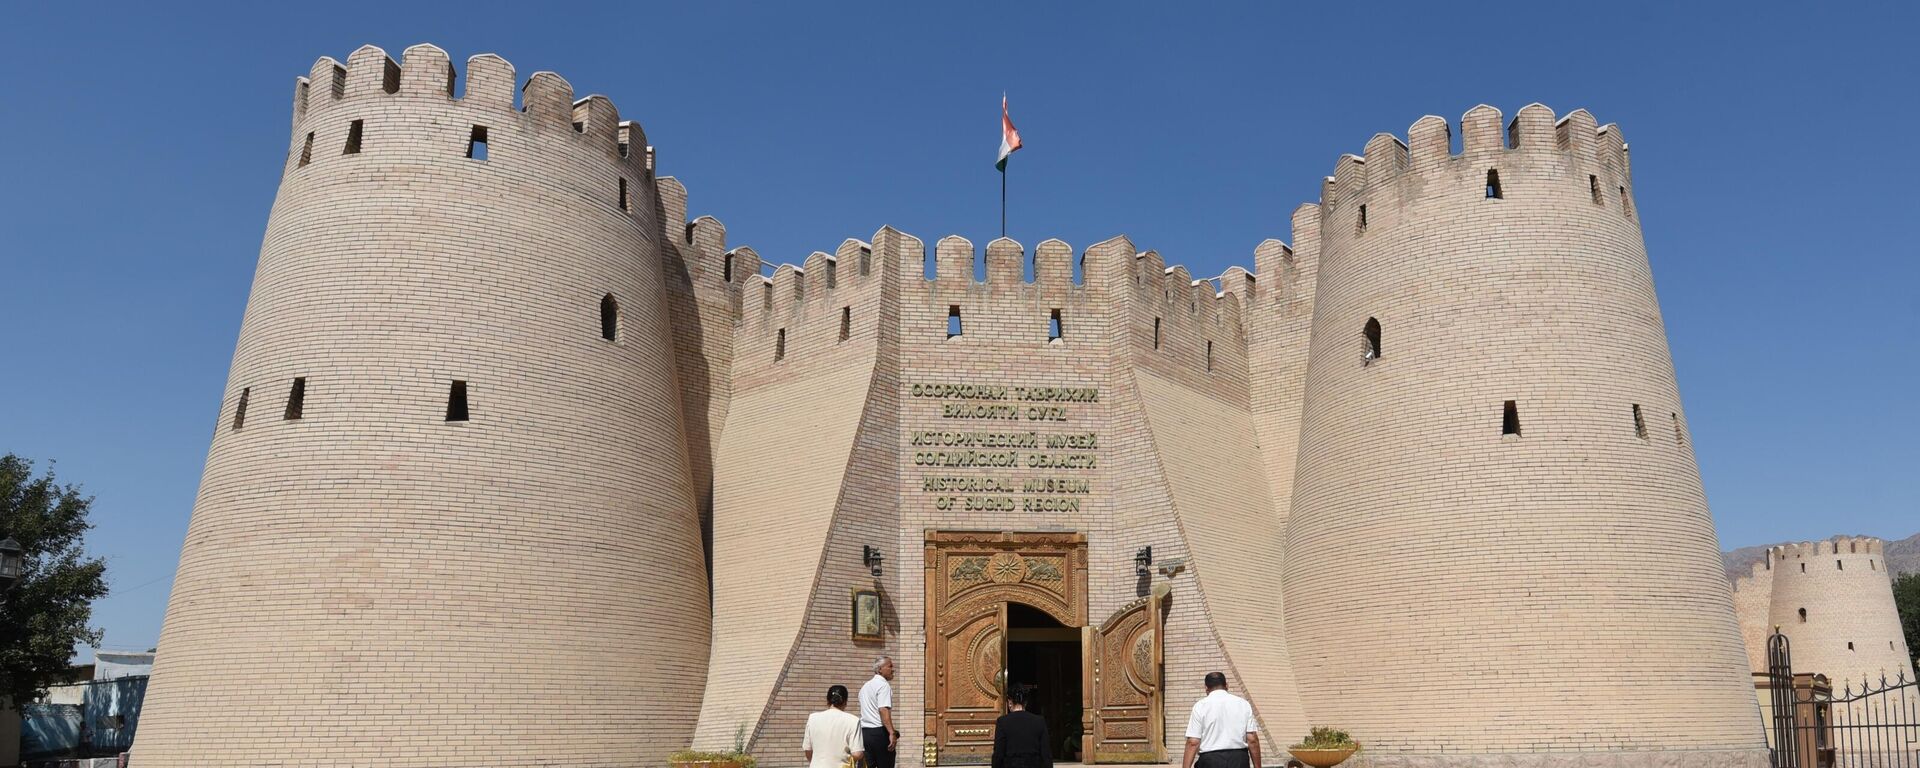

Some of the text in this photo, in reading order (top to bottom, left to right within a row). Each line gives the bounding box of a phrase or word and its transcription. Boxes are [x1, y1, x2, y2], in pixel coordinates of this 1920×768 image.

[912, 384, 1008, 400] ОСОРХОНАИ
[942, 404, 1019, 420] ВИЛОЯТИ
[911, 431, 1098, 449] ИСТОРИЧЕСКИЙ МУЗЕЙ
[915, 451, 1097, 469] СОГДИЙСКОЙ ОБЛАСТИ
[922, 476, 1090, 493] HISTORICAL MUSEUM
[936, 497, 1080, 512] OF SUGHD REGION
